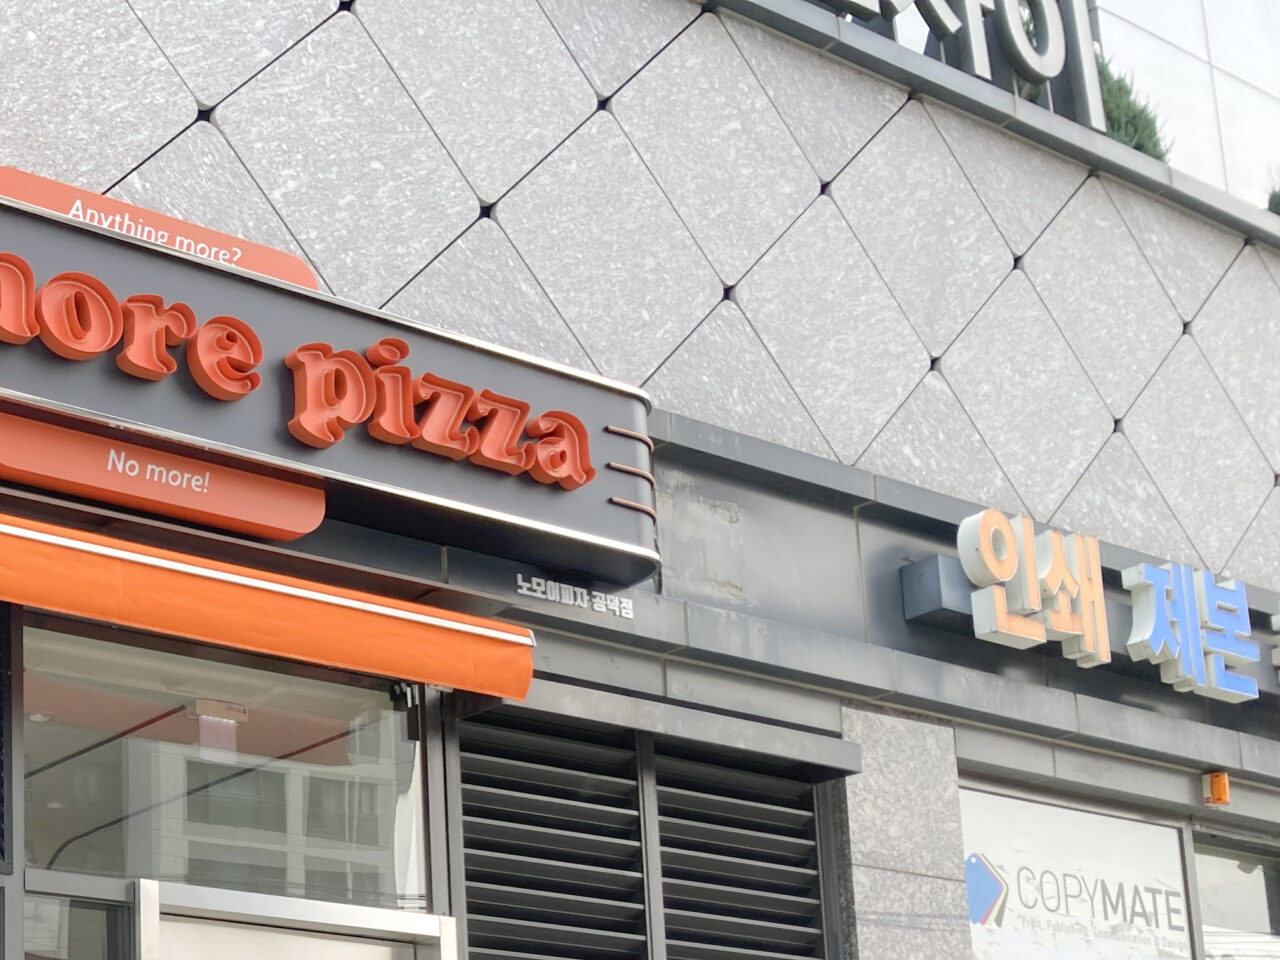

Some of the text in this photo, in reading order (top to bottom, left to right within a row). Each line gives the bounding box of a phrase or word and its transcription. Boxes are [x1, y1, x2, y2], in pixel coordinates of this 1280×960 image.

[68, 199, 243, 267] Anything more?
[285, 337, 597, 491] pizza
[107, 447, 211, 494] No more!
[516, 573, 634, 619] 노모어피자 공덕점
[959, 508, 1112, 668] 인쇄
[1123, 562, 1259, 703] 제본
[1017, 866, 1186, 932] COPYMATE
